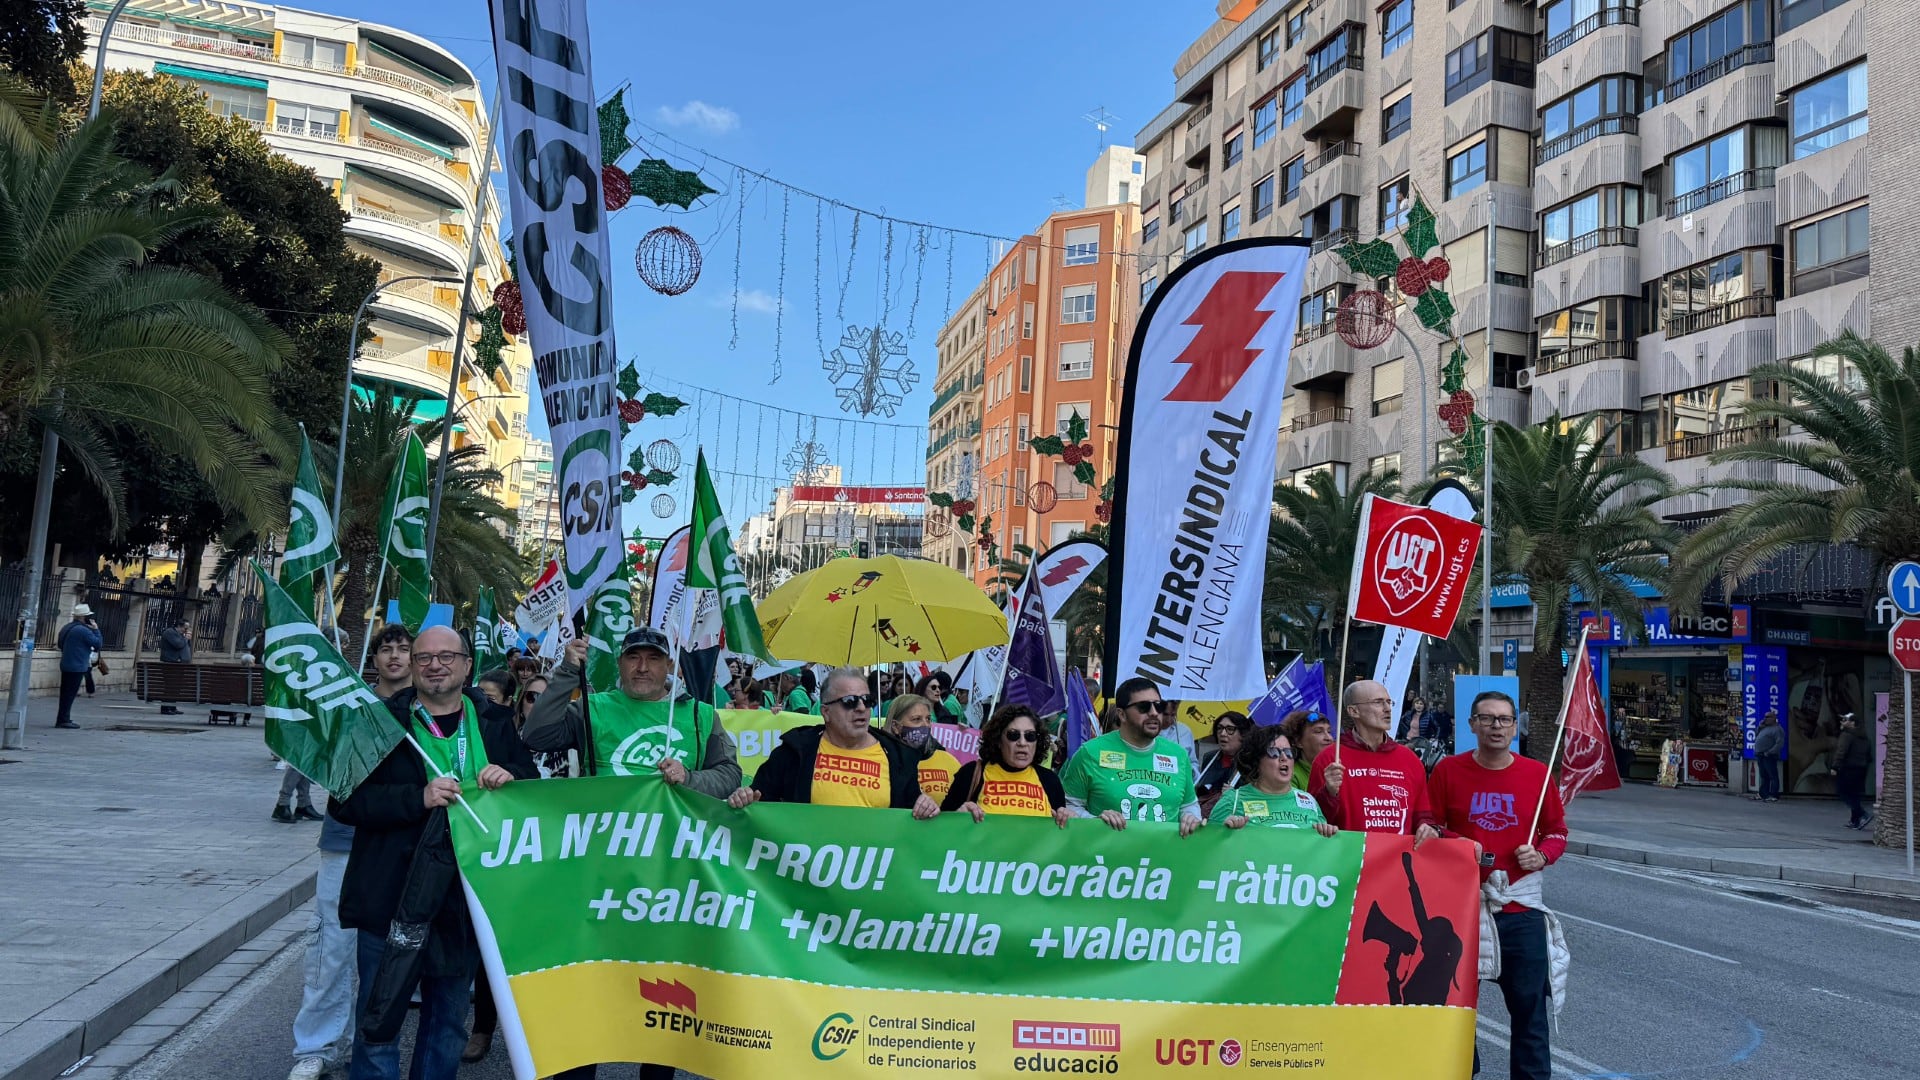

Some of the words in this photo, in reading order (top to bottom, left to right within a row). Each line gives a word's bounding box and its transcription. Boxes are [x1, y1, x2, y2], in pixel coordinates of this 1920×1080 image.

[1134, 408, 1253, 688] INTERSINDICAL
[1386, 530, 1437, 577] UGT
[1431, 537, 1470, 619] www.ugt.es
[1180, 542, 1243, 691] VALENCIANA
[1018, 617, 1046, 637] país
[1767, 630, 1807, 642] CHANGE
[264, 644, 381, 712] CSIF
[813, 770, 881, 790] educació
[1348, 768, 1368, 778] UGT
[983, 795, 1045, 812] educació
[1362, 796, 1398, 807] Salvem
[1471, 791, 1516, 815] UGT
[1363, 807, 1400, 817] l'escola
[1365, 817, 1400, 829] pública
[480, 816, 543, 868] JA
[671, 815, 732, 867] HA
[745, 838, 895, 891] PROU!
[920, 849, 1172, 900] -burocràcia
[1197, 861, 1340, 908] -ràtios
[588, 879, 757, 930] +salari
[780, 908, 1001, 957] +plantilla
[1029, 914, 1243, 965] +valencià
[644, 1009, 703, 1038] STEPV
[706, 1021, 774, 1040] INTERSINDICAL
[868, 1015, 918, 1031] Central
[921, 1016, 976, 1033] Sindical
[713, 1032, 773, 1051] VALENCIANA
[822, 1025, 859, 1045] CSIF
[868, 1034, 964, 1052] Independiente
[967, 1040, 976, 1054] y
[1154, 1037, 1215, 1066] UGT
[1250, 1039, 1325, 1055] Ensenyament
[868, 1053, 885, 1067] de
[887, 1055, 978, 1071] Funcionarios
[1013, 1052, 1119, 1076] educació
[1249, 1056, 1282, 1069] Serveis
[1283, 1056, 1313, 1069] Públics
[1314, 1057, 1326, 1069] PV
